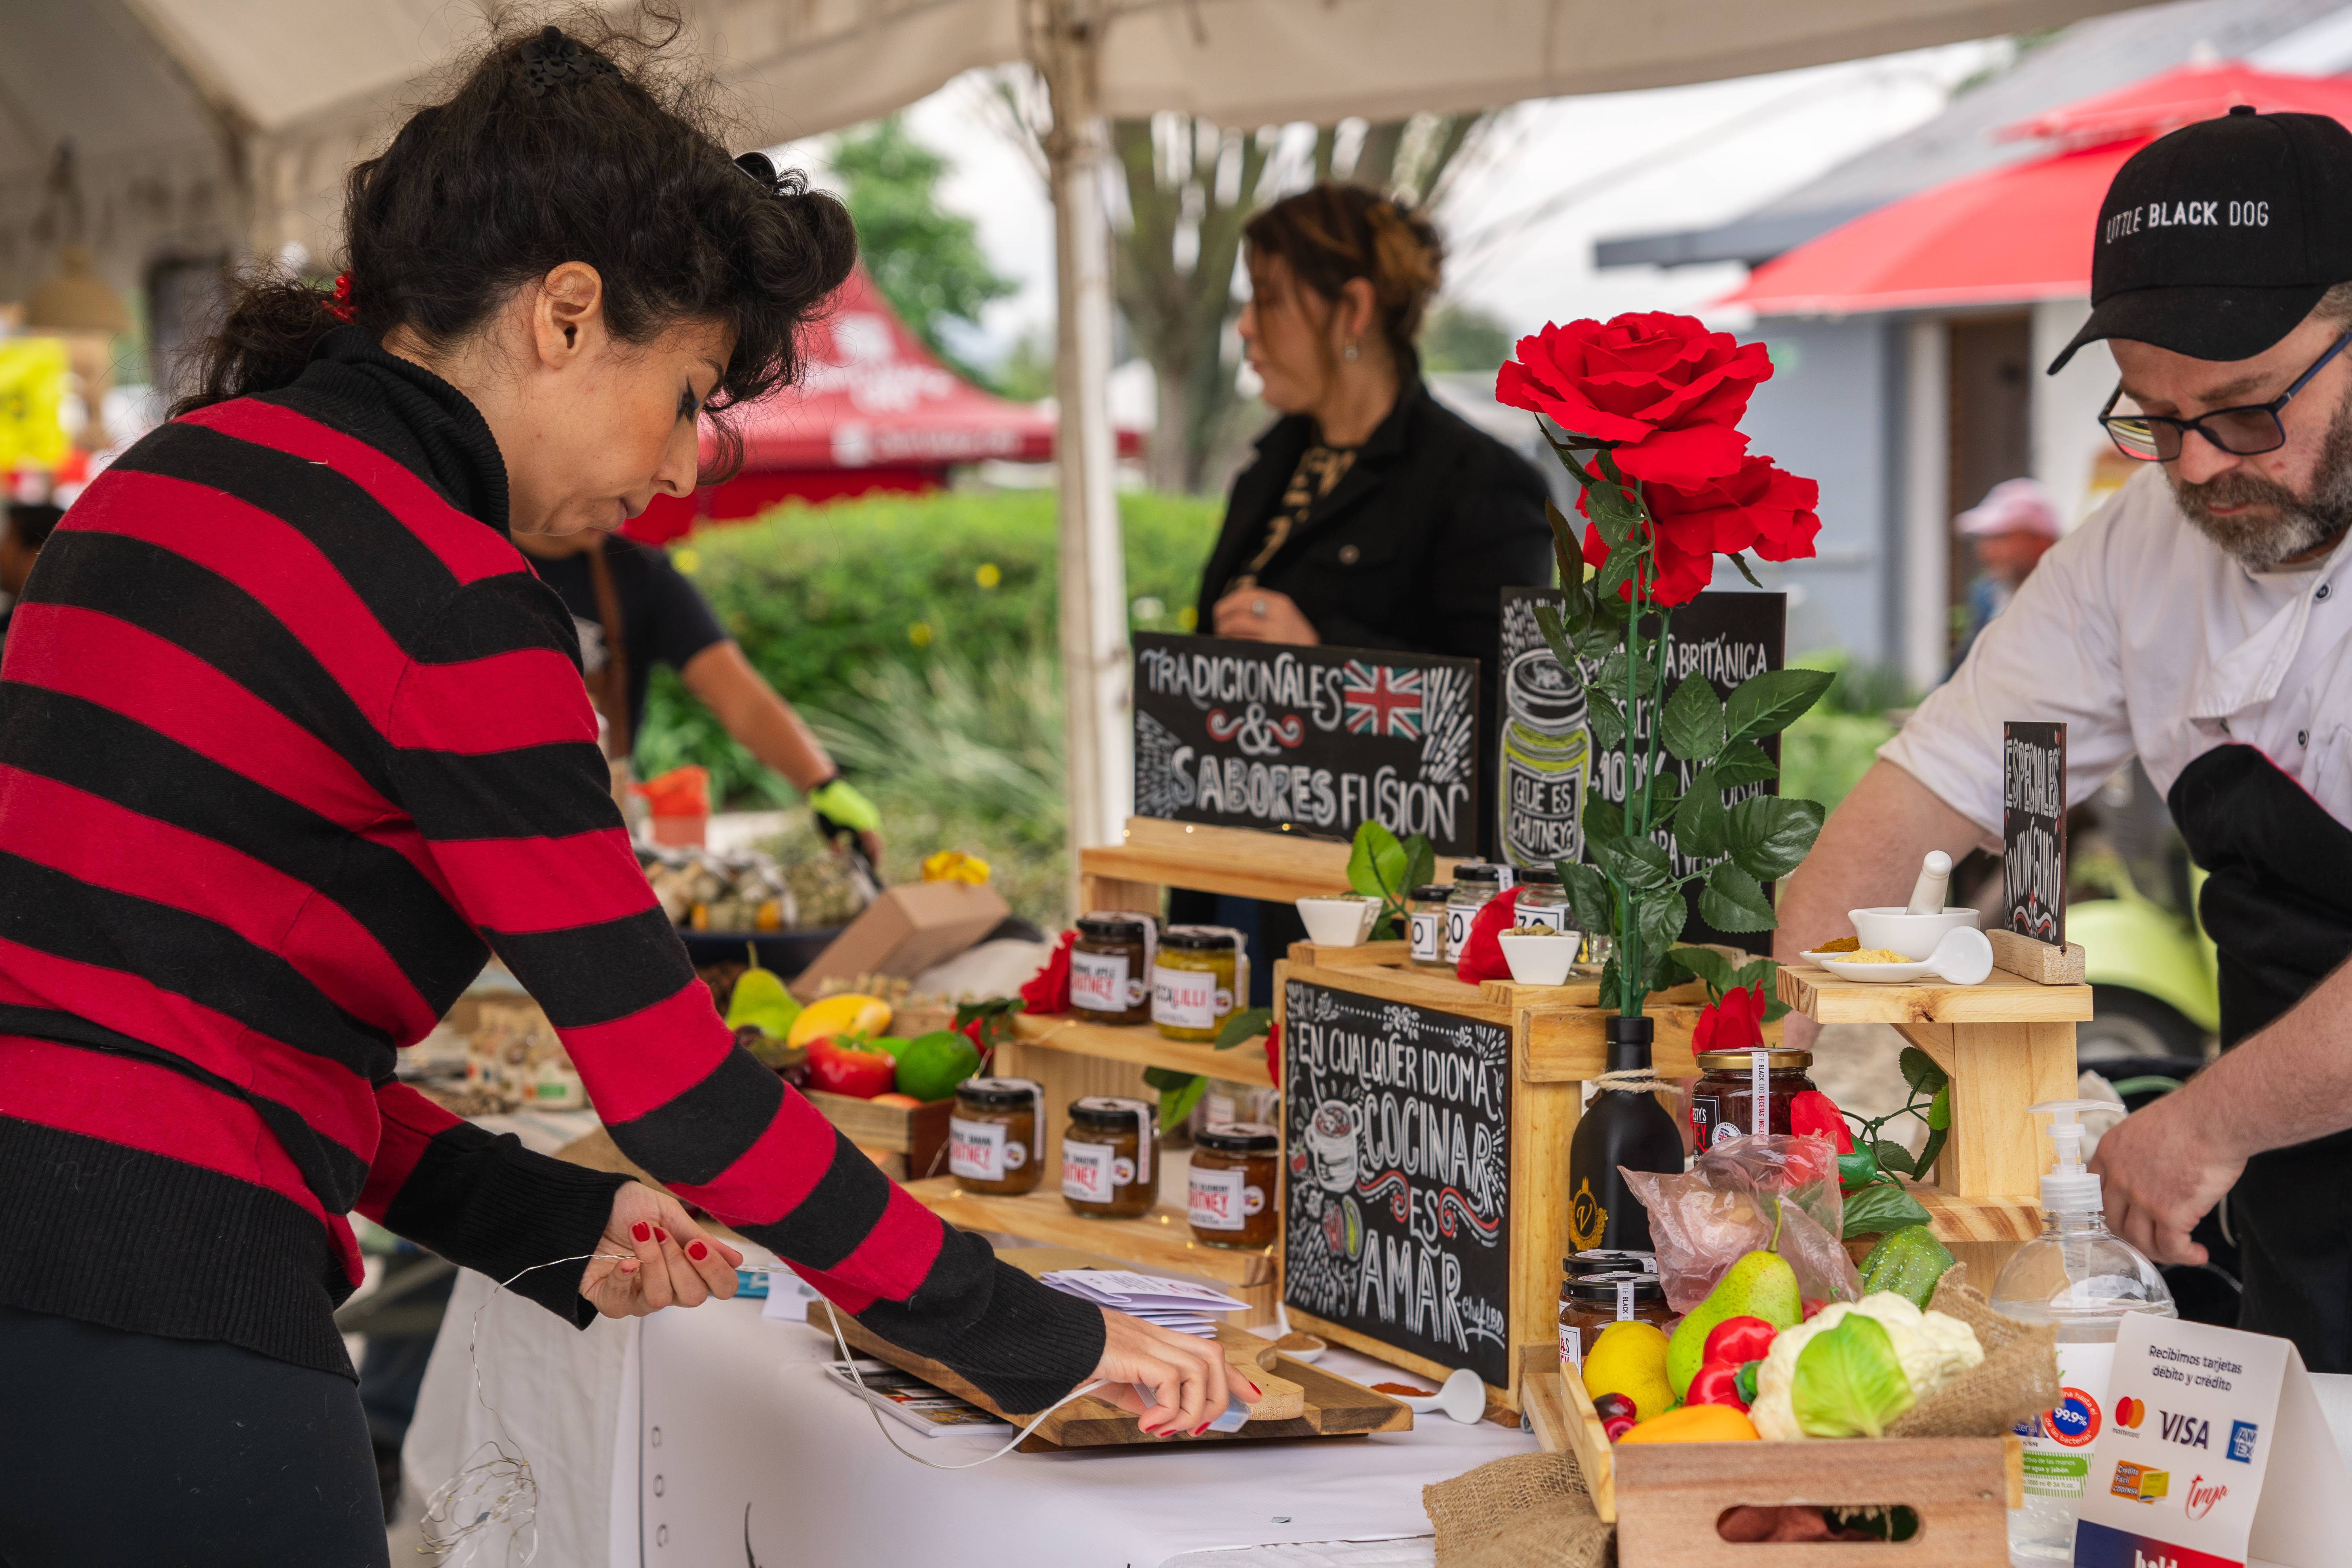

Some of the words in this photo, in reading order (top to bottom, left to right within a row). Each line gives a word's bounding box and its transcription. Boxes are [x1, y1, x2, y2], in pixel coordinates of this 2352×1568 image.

[2105, 206, 2143, 244] LITTLE
[2148, 201, 2219, 227] BLACK
[2229, 201, 2269, 226] DOG
[1140, 648, 1343, 731] TRADICIONALES
[1237, 703, 1282, 755] &
[1171, 745, 1338, 827] SABORES
[1513, 774, 1545, 812] QUE
[1551, 782, 1571, 814] ES
[2006, 737, 2059, 819] ESPECIALES
[1512, 810, 1574, 855] CHUTNEY?
[1298, 1022, 1325, 1076] EN
[1329, 1027, 1417, 1091] CUALQUIER
[1423, 1048, 1498, 1122] IDIOMA
[1713, 1124, 1724, 1138] CONCEPTO
[1362, 1092, 1493, 1216] COCINAR
[1409, 1186, 1441, 1257] ES
[1356, 1229, 1468, 1353] AMAR
[2148, 1344, 2201, 1366] Recibimos
[2203, 1356, 2243, 1374] tarjetas
[2152, 1364, 2185, 1381] débito
[2184, 1373, 2194, 1386] y
[2194, 1374, 2232, 1391] crédito
[2054, 1407, 2087, 1427] 99.9%
[2074, 1391, 2092, 1408] hasta
[2089, 1407, 2098, 1415] el
[2050, 1428, 2059, 1438] las
[2111, 1428, 2140, 1439] mastercard
[2158, 1410, 2211, 1450] VISA
[2112, 1484, 2139, 1495] CODENSA
[2118, 1465, 2139, 1476] Crédito
